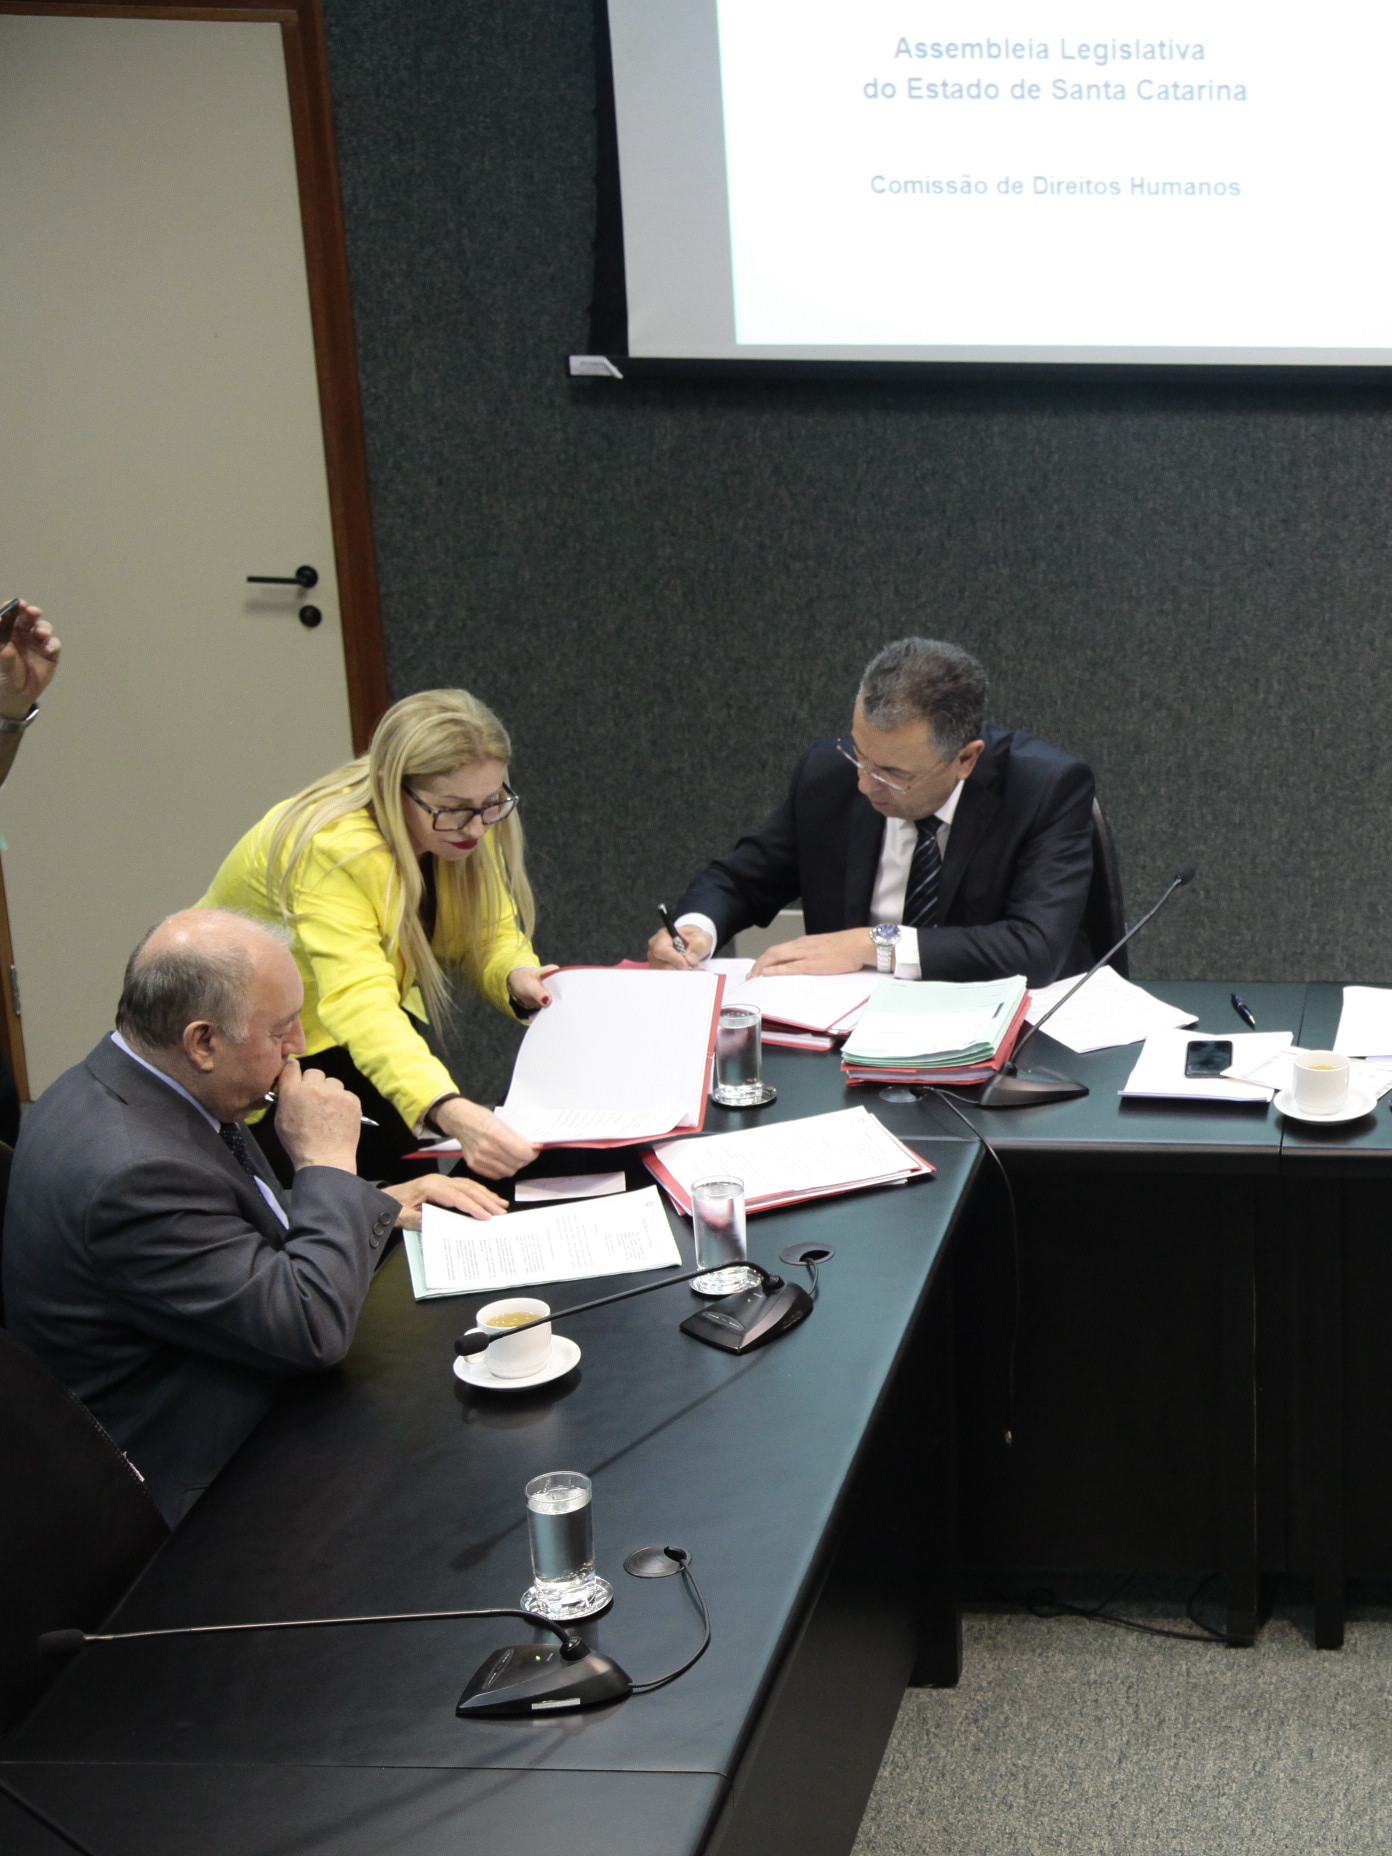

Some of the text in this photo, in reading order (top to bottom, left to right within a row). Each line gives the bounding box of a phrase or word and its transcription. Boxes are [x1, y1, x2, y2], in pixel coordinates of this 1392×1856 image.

[894, 37, 1205, 66] Assembleia Legislativa
[863, 77, 1248, 101] do Estado de Santa Catarina
[871, 174, 1241, 196] Comissão de Direitos Humanos
